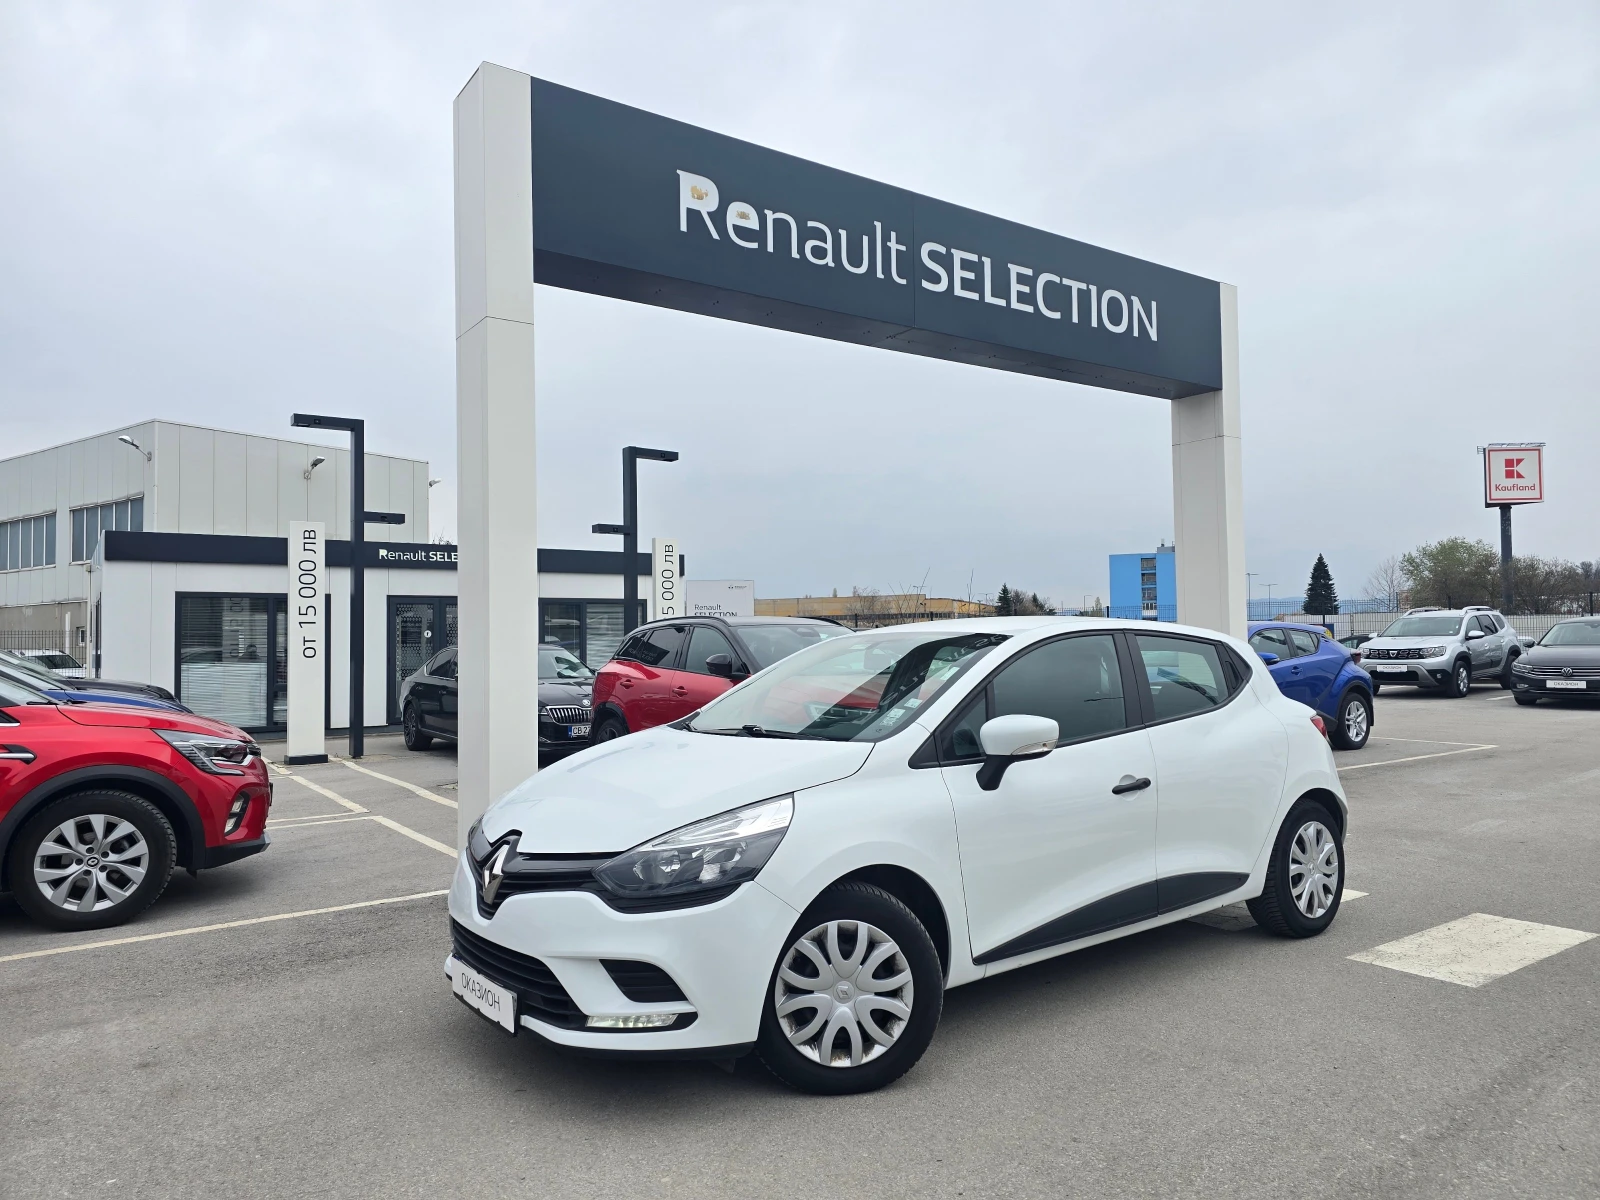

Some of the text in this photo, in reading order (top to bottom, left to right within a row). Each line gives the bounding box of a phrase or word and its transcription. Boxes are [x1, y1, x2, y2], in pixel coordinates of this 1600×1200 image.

[676, 169, 1158, 342] Renault SELECTION
[1495, 483, 1535, 491] Kaufland
[378, 548, 426, 561] Renault
[298, 559, 317, 599] 000
[661, 569, 674, 601] 000
[298, 605, 317, 628] 15
[461, 973, 500, 1011] ОКАЗИОН
